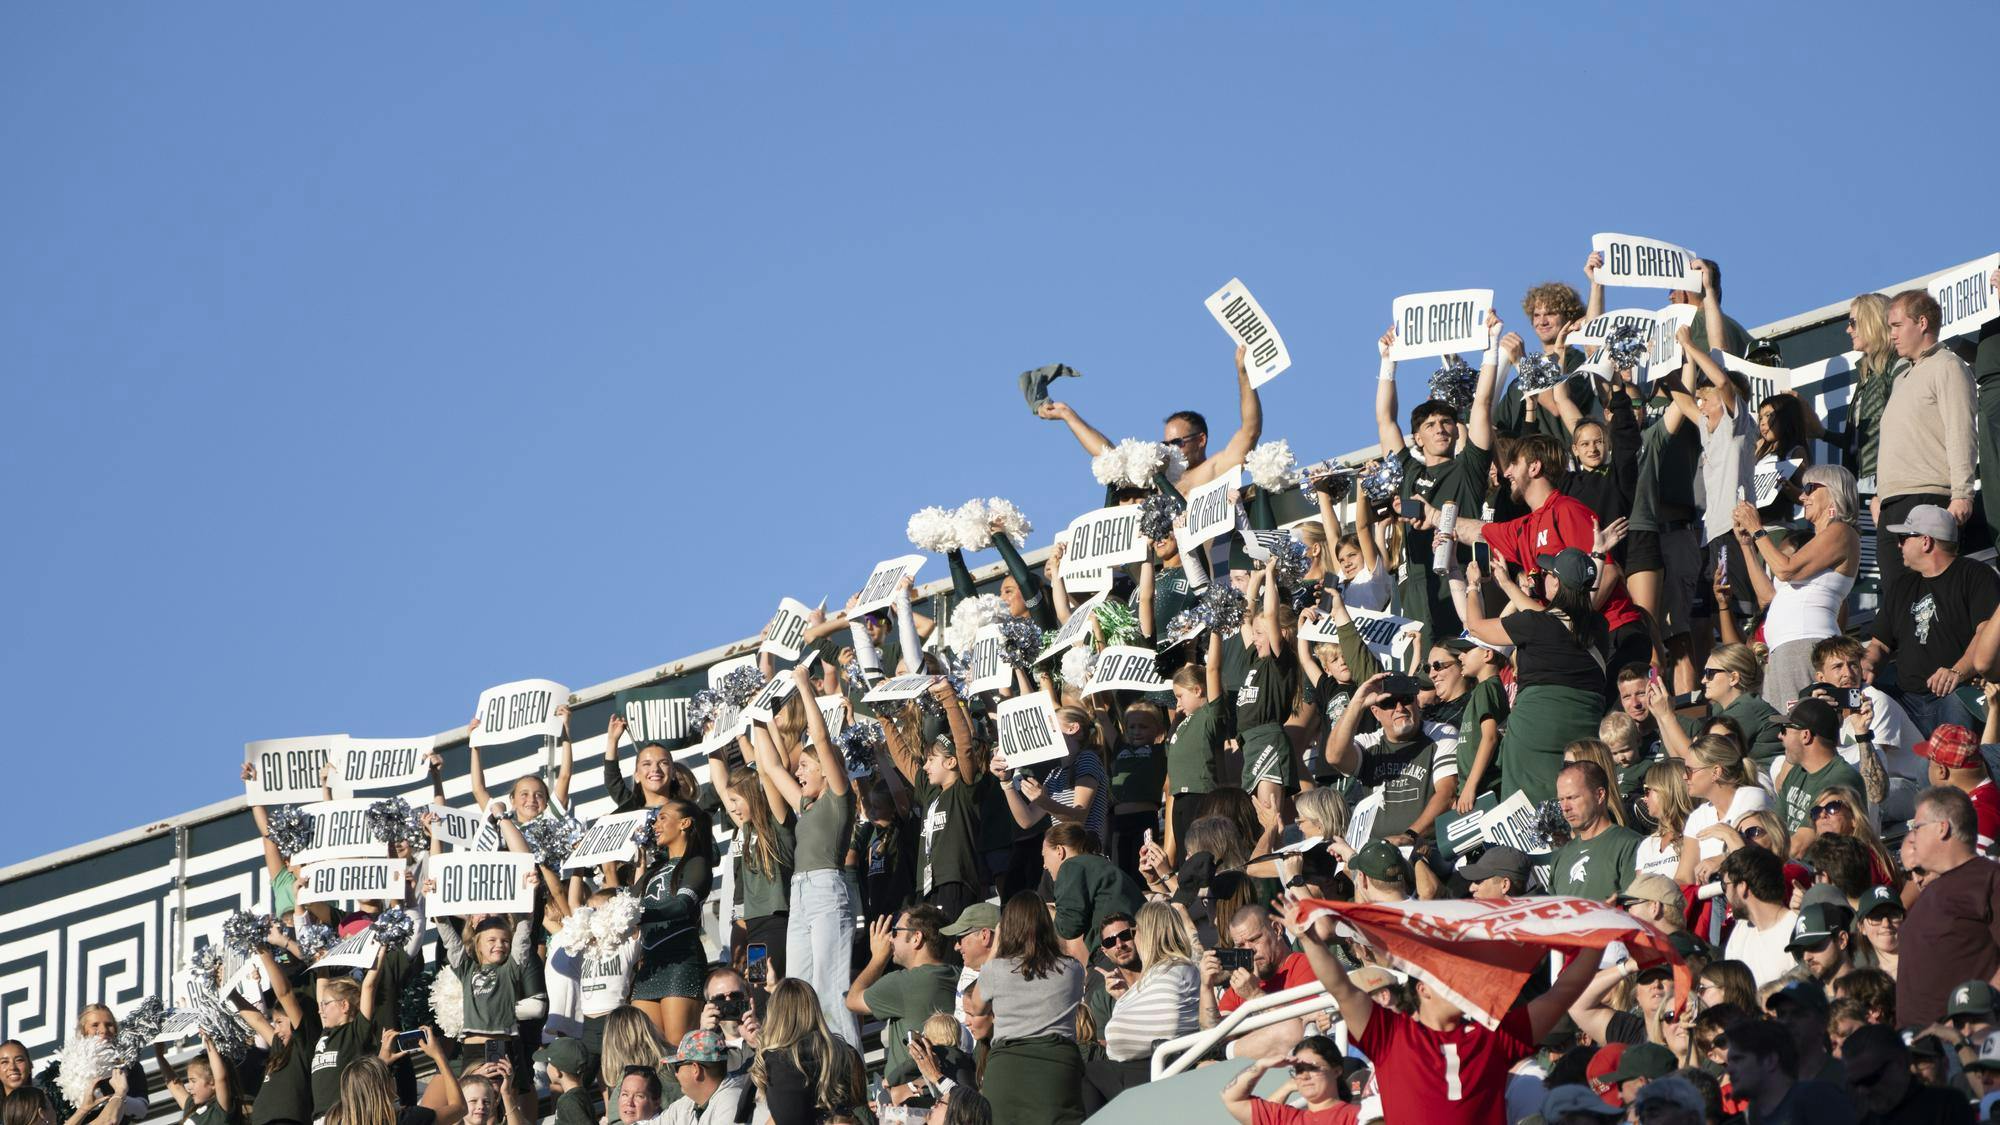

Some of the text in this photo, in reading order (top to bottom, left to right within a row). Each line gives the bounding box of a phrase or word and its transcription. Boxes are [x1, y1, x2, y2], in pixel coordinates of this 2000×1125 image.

[1610, 242, 1685, 279] GO GREEN
[1939, 270, 1988, 328] GO GREEN
[1221, 295, 1279, 368] GO GREEN
[1404, 301, 1474, 346] GO GREEN
[1584, 316, 1610, 338] GO
[1190, 481, 1230, 536] GO GREEN
[1070, 515, 1137, 562] GO GREEN
[1536, 528, 1548, 548] N
[973, 637, 999, 681] REEN
[1096, 654, 1122, 684] GO
[485, 690, 552, 733] GO GREEN
[626, 701, 645, 743] GO
[1001, 705, 1053, 756] GO GREEN
[261, 751, 283, 792] GO
[345, 747, 418, 781] GO GREEN
[446, 813, 467, 839] GO
[314, 865, 388, 894] GO GREEN
[443, 863, 517, 904] GO GREEN
[1438, 1043, 1462, 1101] 1
